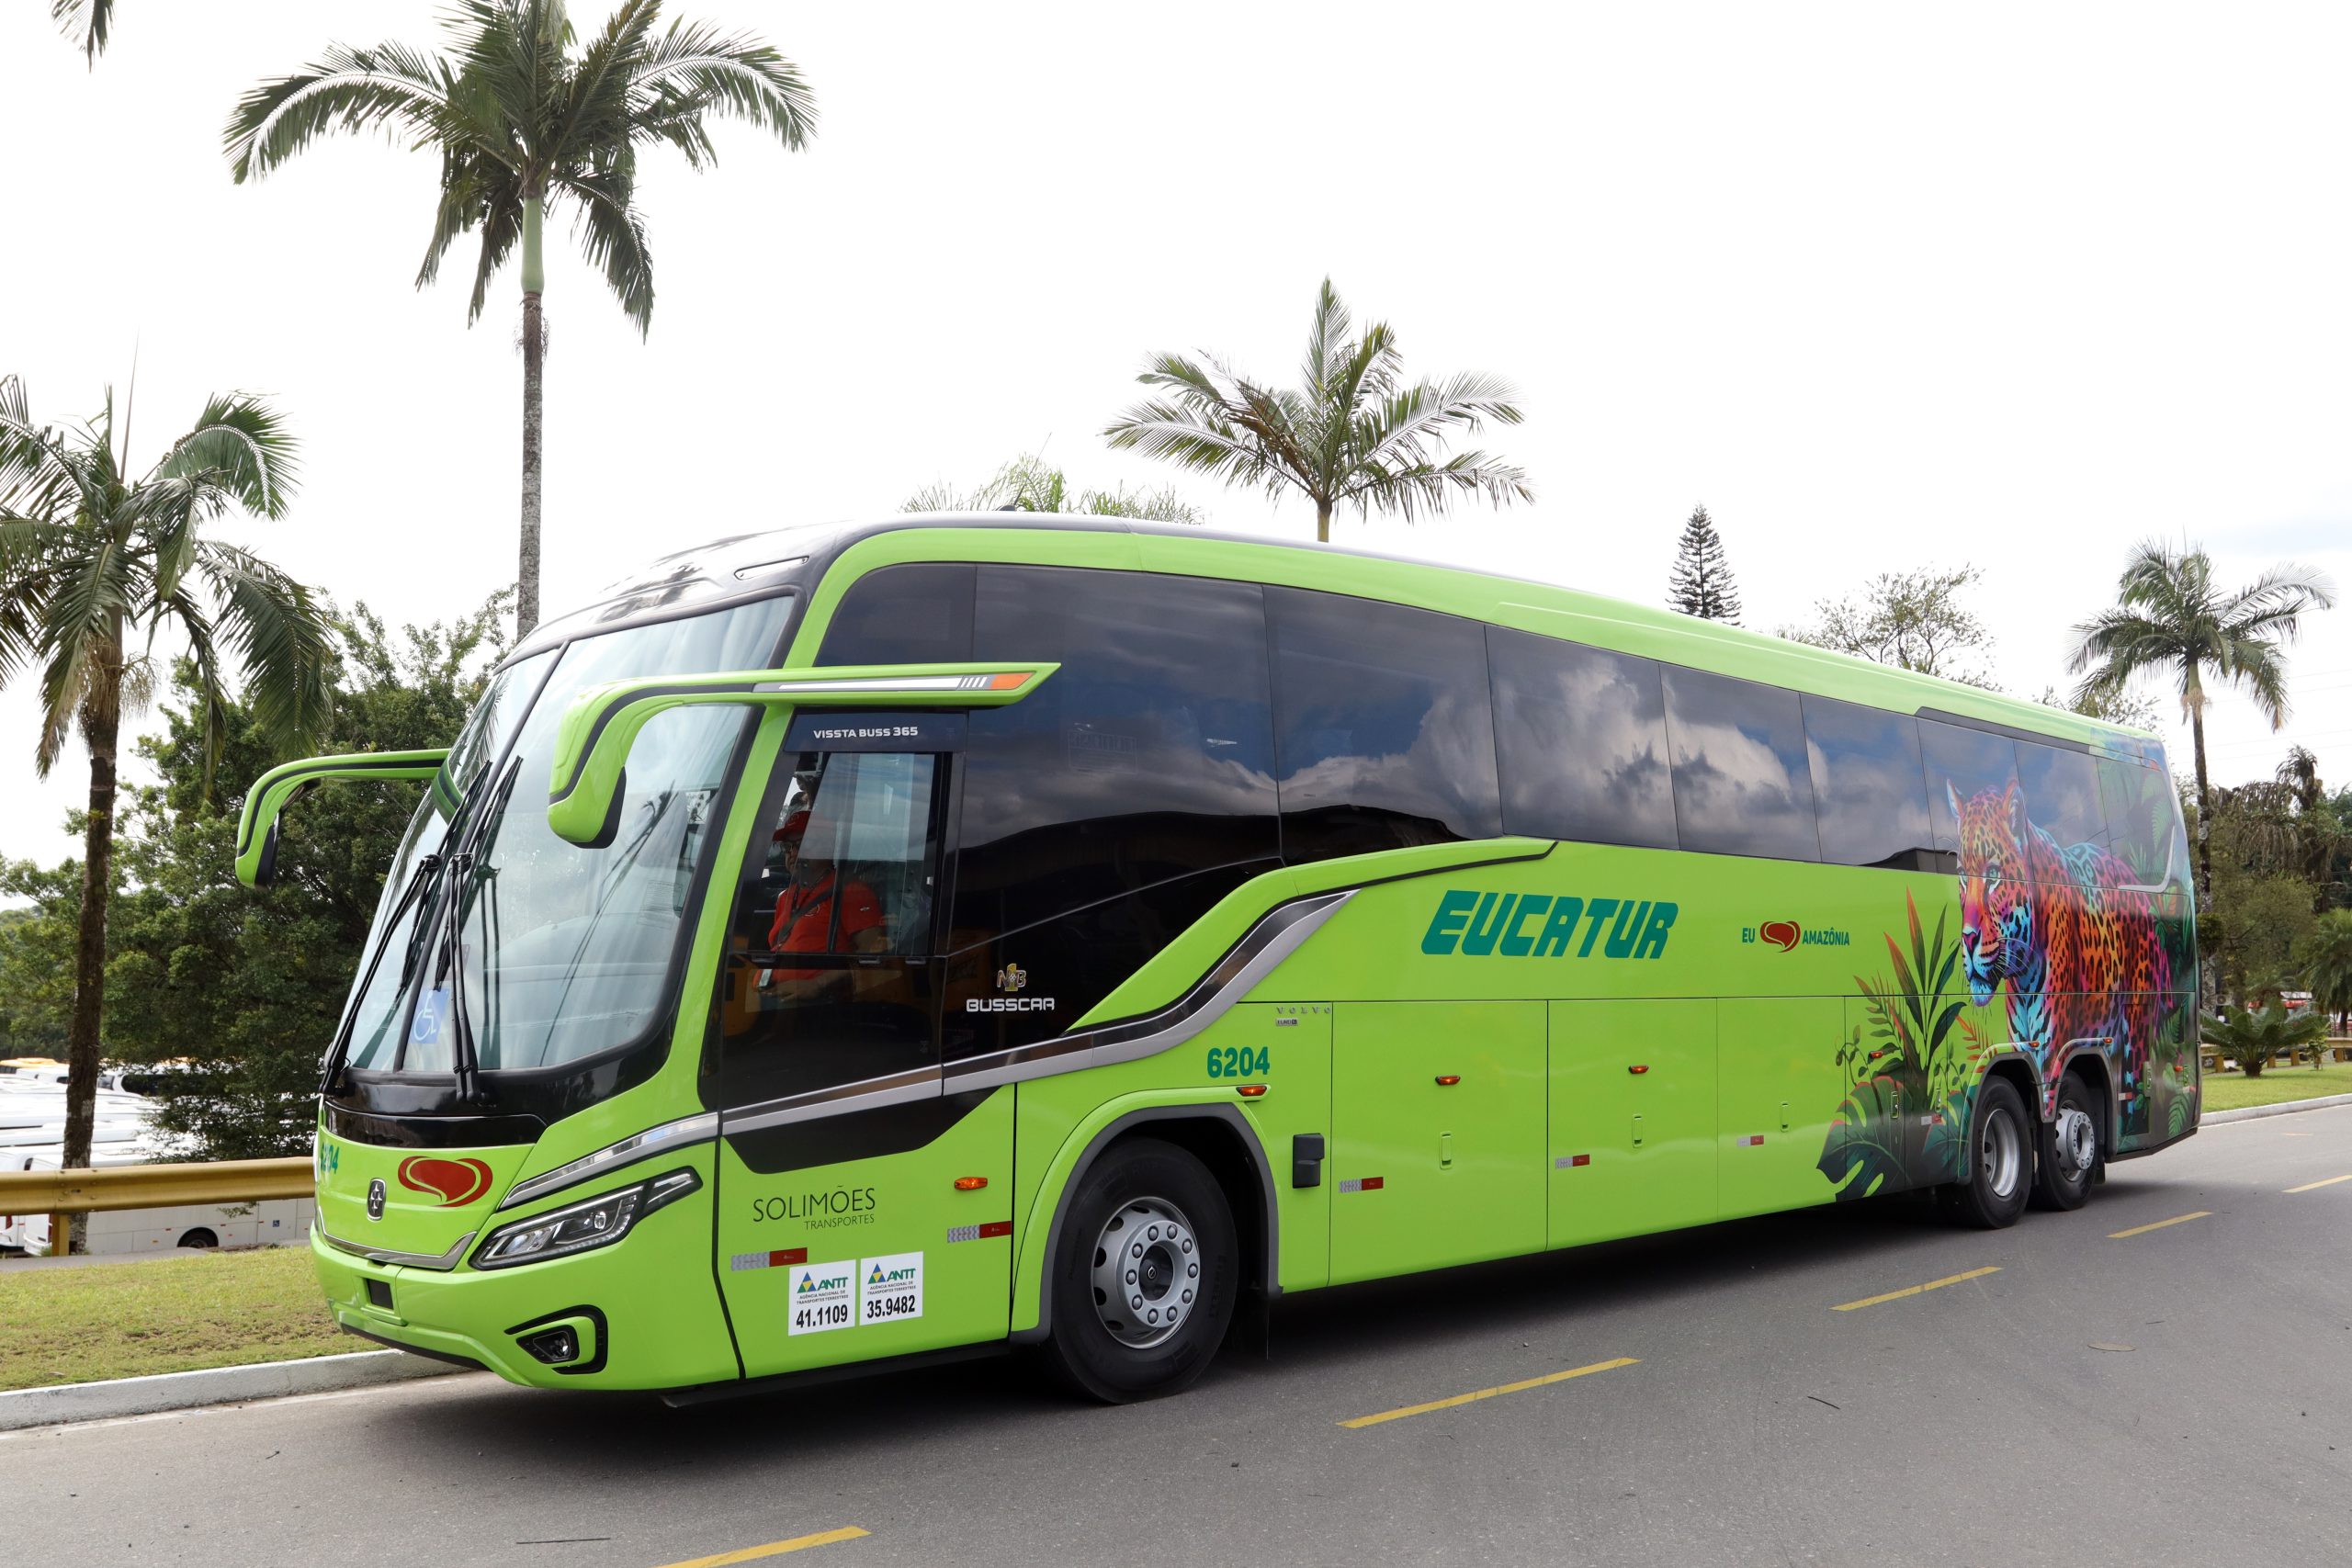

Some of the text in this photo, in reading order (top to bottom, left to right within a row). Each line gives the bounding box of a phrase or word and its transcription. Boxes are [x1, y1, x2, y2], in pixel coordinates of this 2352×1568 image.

[813, 727, 918, 739] VISSTA BUSS 365
[1420, 889, 1679, 959] EUCATUR
[1742, 926, 1850, 946] EU AMAZÔNIA
[966, 998, 1055, 1012] BUSSCAR
[1276, 1007, 1331, 1015] VOLVO
[1206, 1046, 1271, 1078] 6204
[752, 1185, 876, 1223] SOLIMÕES
[804, 1213, 875, 1231] TRANSPORTES
[817, 1277, 848, 1291] ANTT
[886, 1268, 916, 1281] ANTT
[796, 1304, 848, 1328] 41.1109
[866, 1294, 916, 1319] 35.9482
